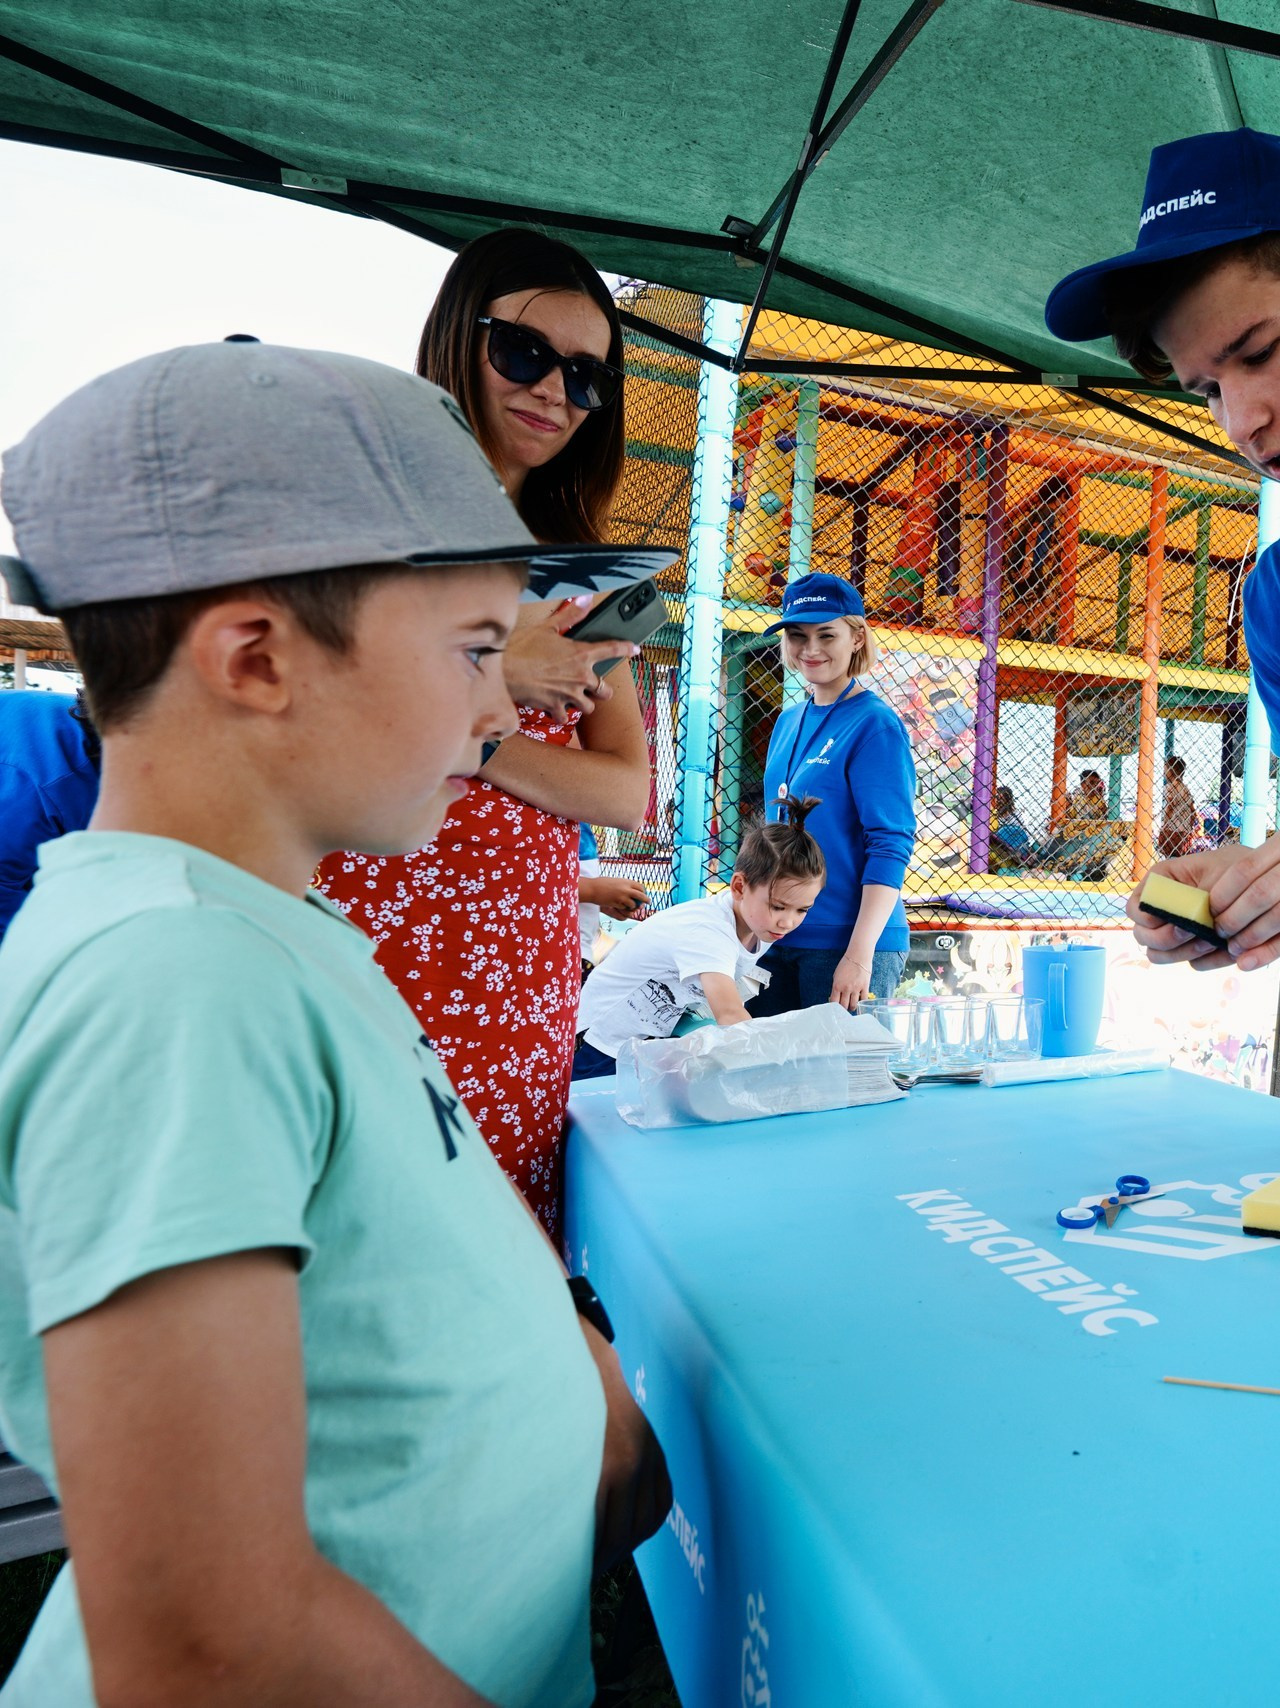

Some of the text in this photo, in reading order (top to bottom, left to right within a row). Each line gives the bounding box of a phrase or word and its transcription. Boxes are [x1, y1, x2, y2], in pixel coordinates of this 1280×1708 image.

[1139, 189, 1217, 231] ИДСПЕЙС
[895, 1188, 1160, 1337] КИДСПЕЙС
[665, 1497, 706, 1596] СПЕЙС
